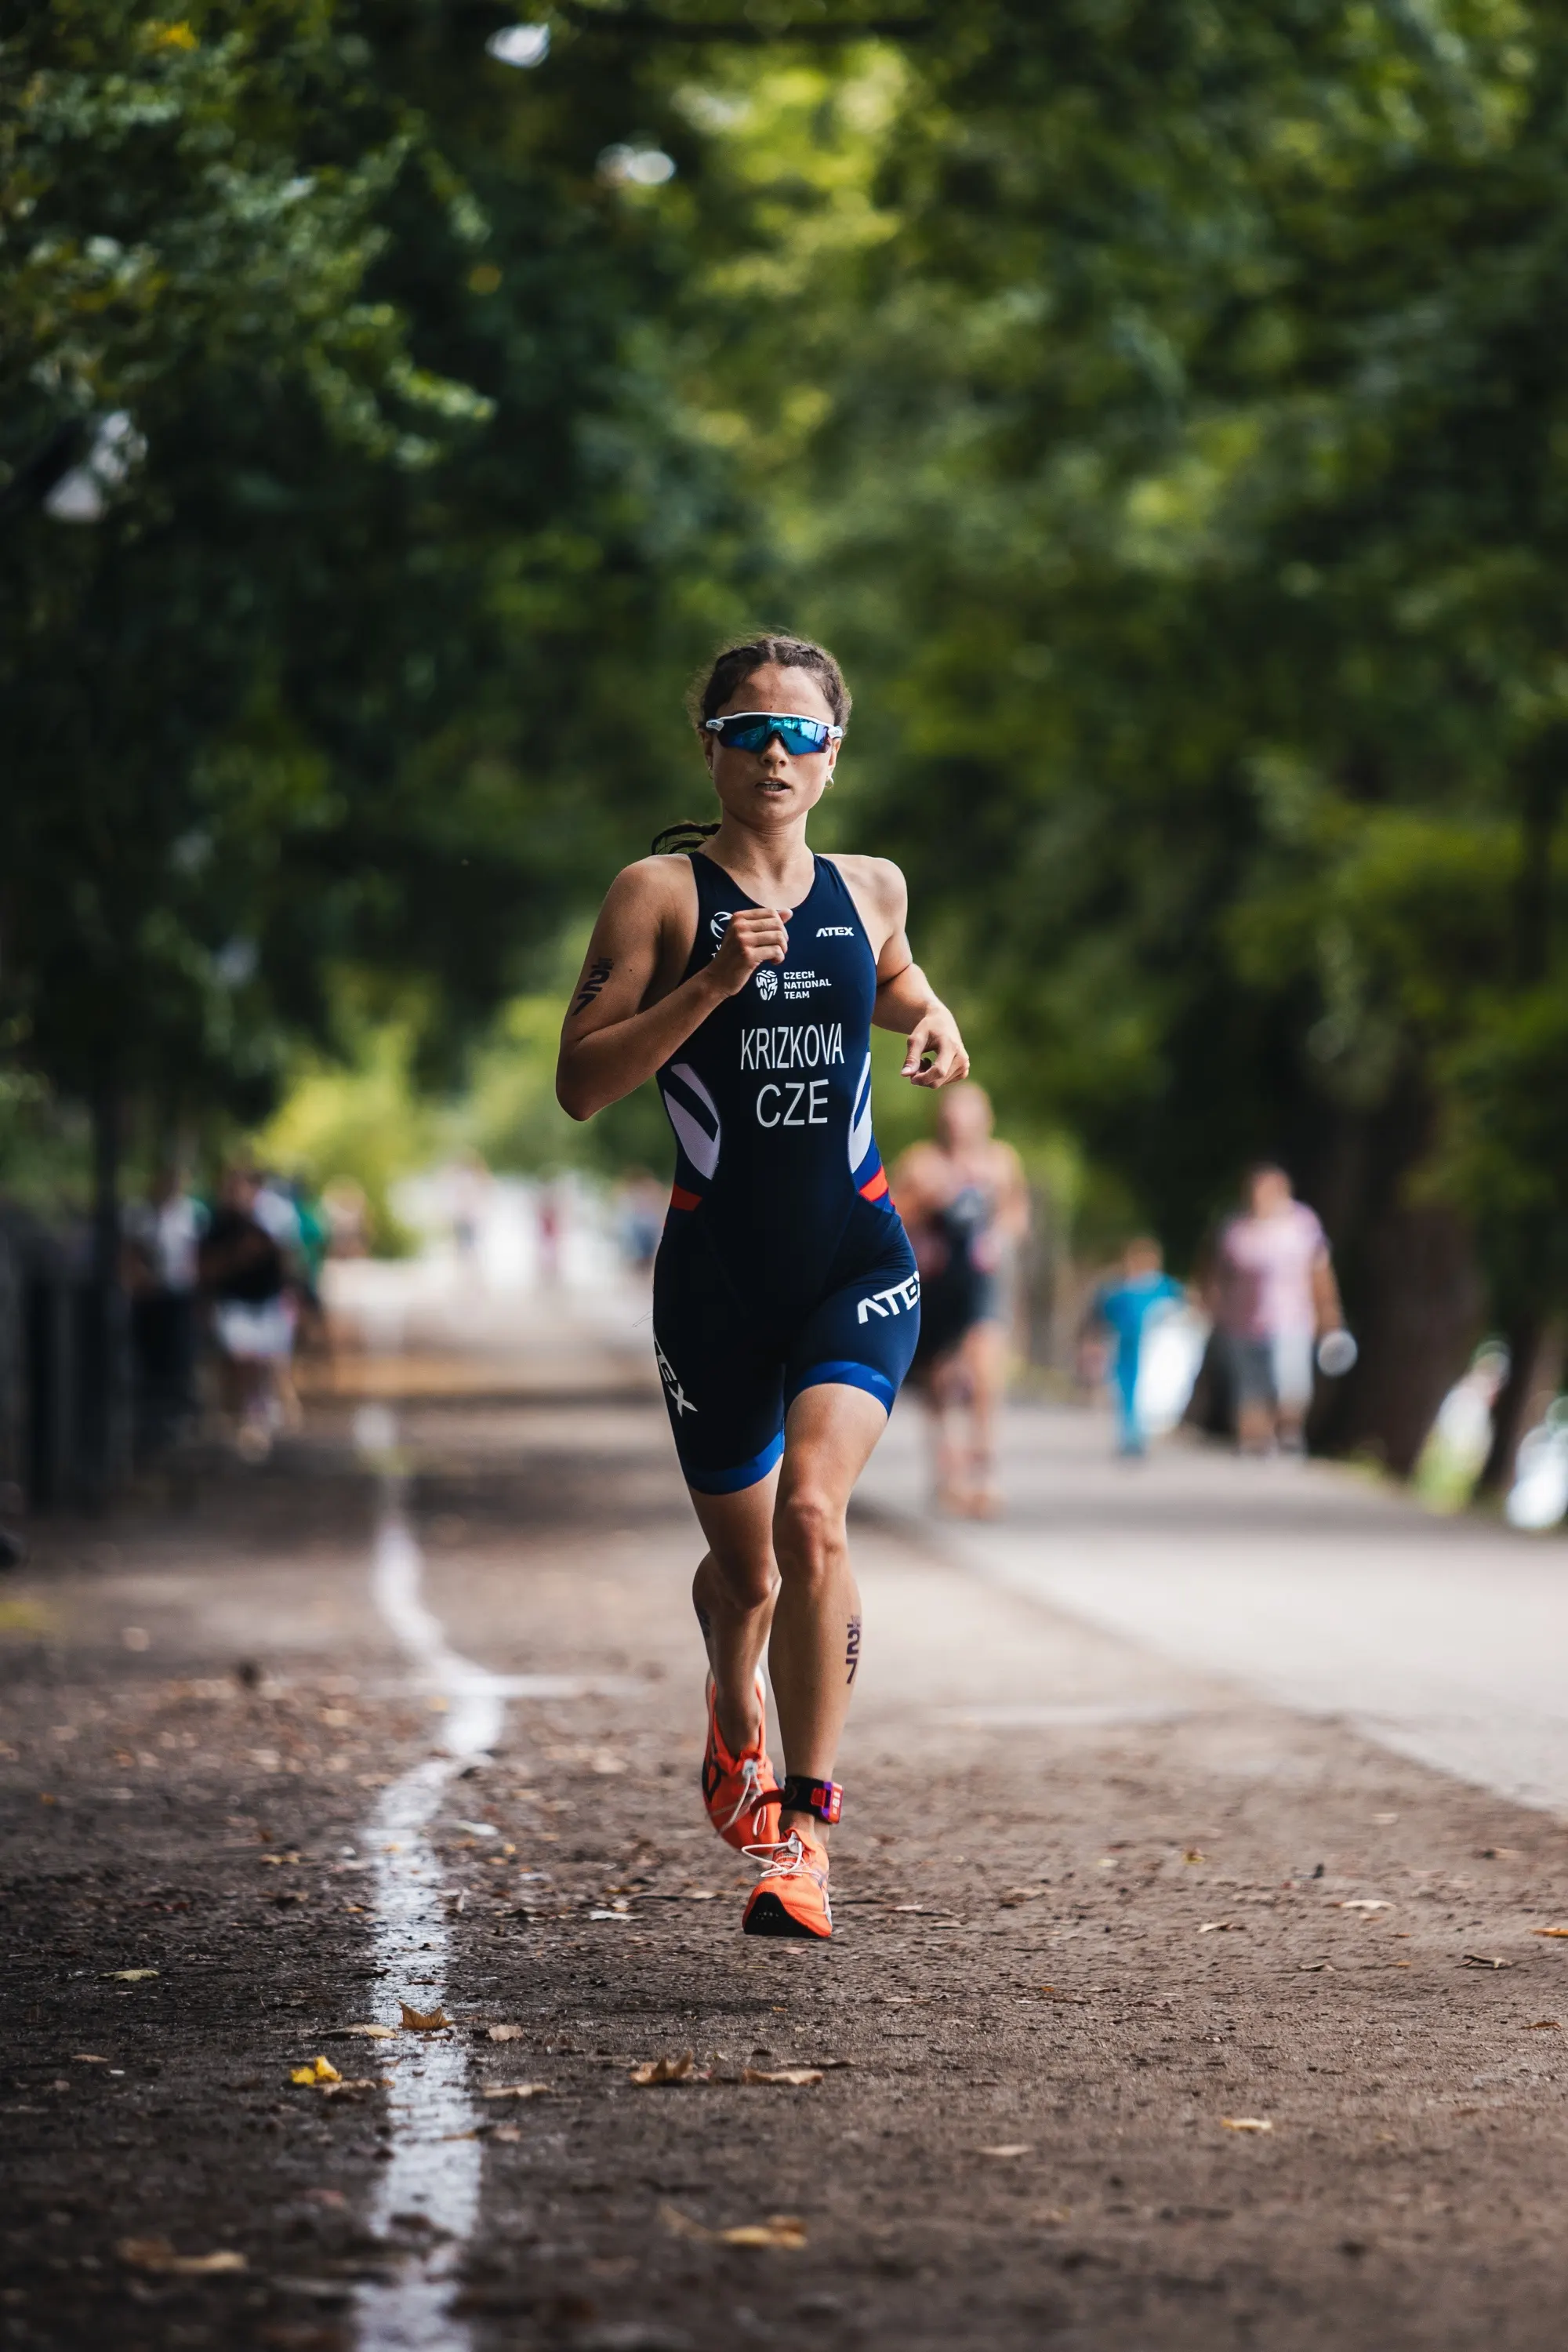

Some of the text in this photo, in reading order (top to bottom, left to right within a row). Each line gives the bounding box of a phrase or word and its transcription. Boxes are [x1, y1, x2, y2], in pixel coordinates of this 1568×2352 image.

[816, 927, 855, 938] ATEX
[783, 971, 815, 980] CZECH
[783, 978, 832, 989] NATIONAL
[784, 990, 810, 1000] TEAM
[740, 1022, 845, 1070] KRIZKOVA
[756, 1079, 829, 1128] CZE
